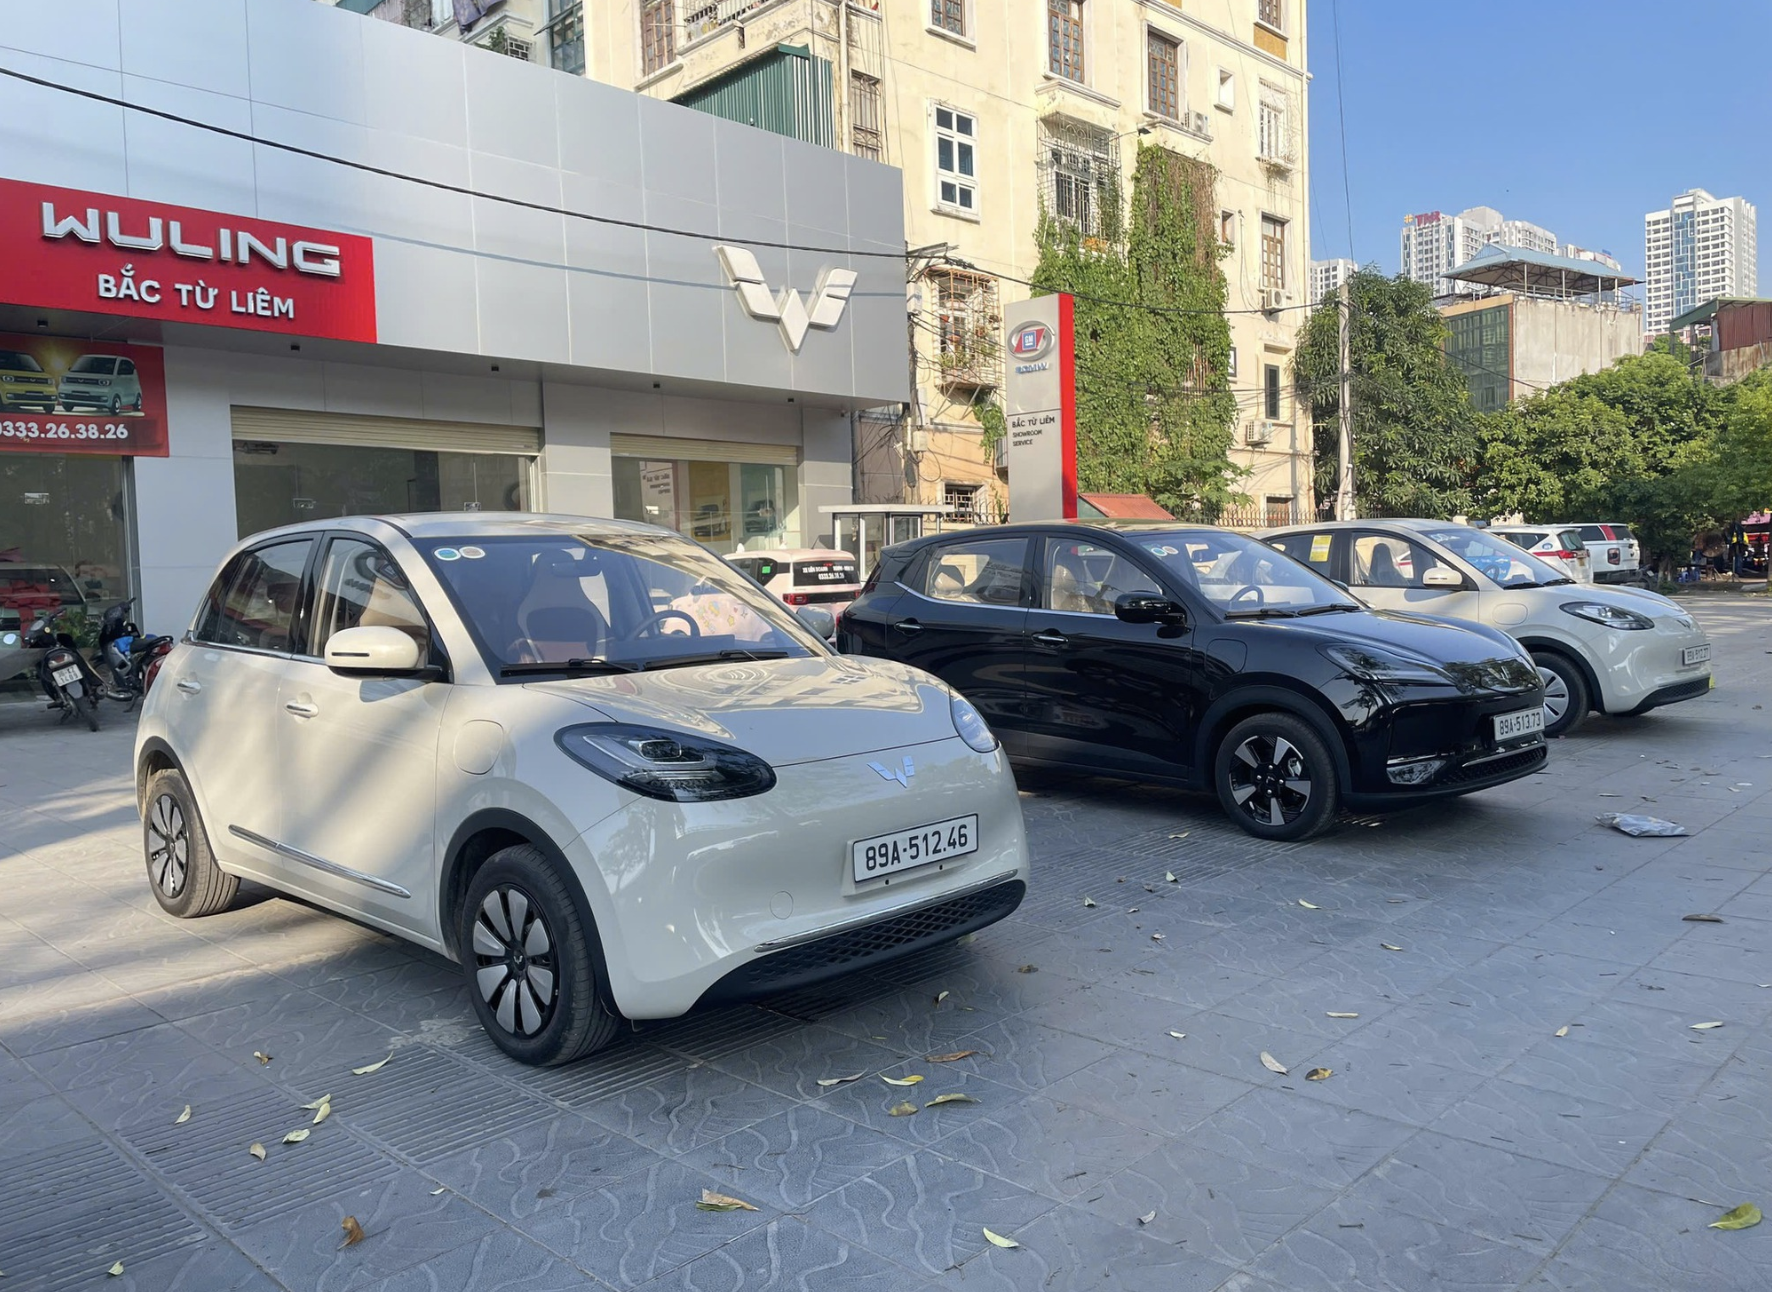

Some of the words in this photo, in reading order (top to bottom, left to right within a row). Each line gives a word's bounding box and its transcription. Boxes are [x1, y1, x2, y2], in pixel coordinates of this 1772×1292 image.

[42, 202, 341, 277] WULING
[98, 263, 162, 303] BẮC
[175, 280, 218, 309] TỪ
[231, 287, 294, 318] LIÊM
[0, 420, 129, 439] 333.26.38.26
[1040, 415, 1055, 425] LIÊM
[1013, 430, 1042, 438] SHOWROOM
